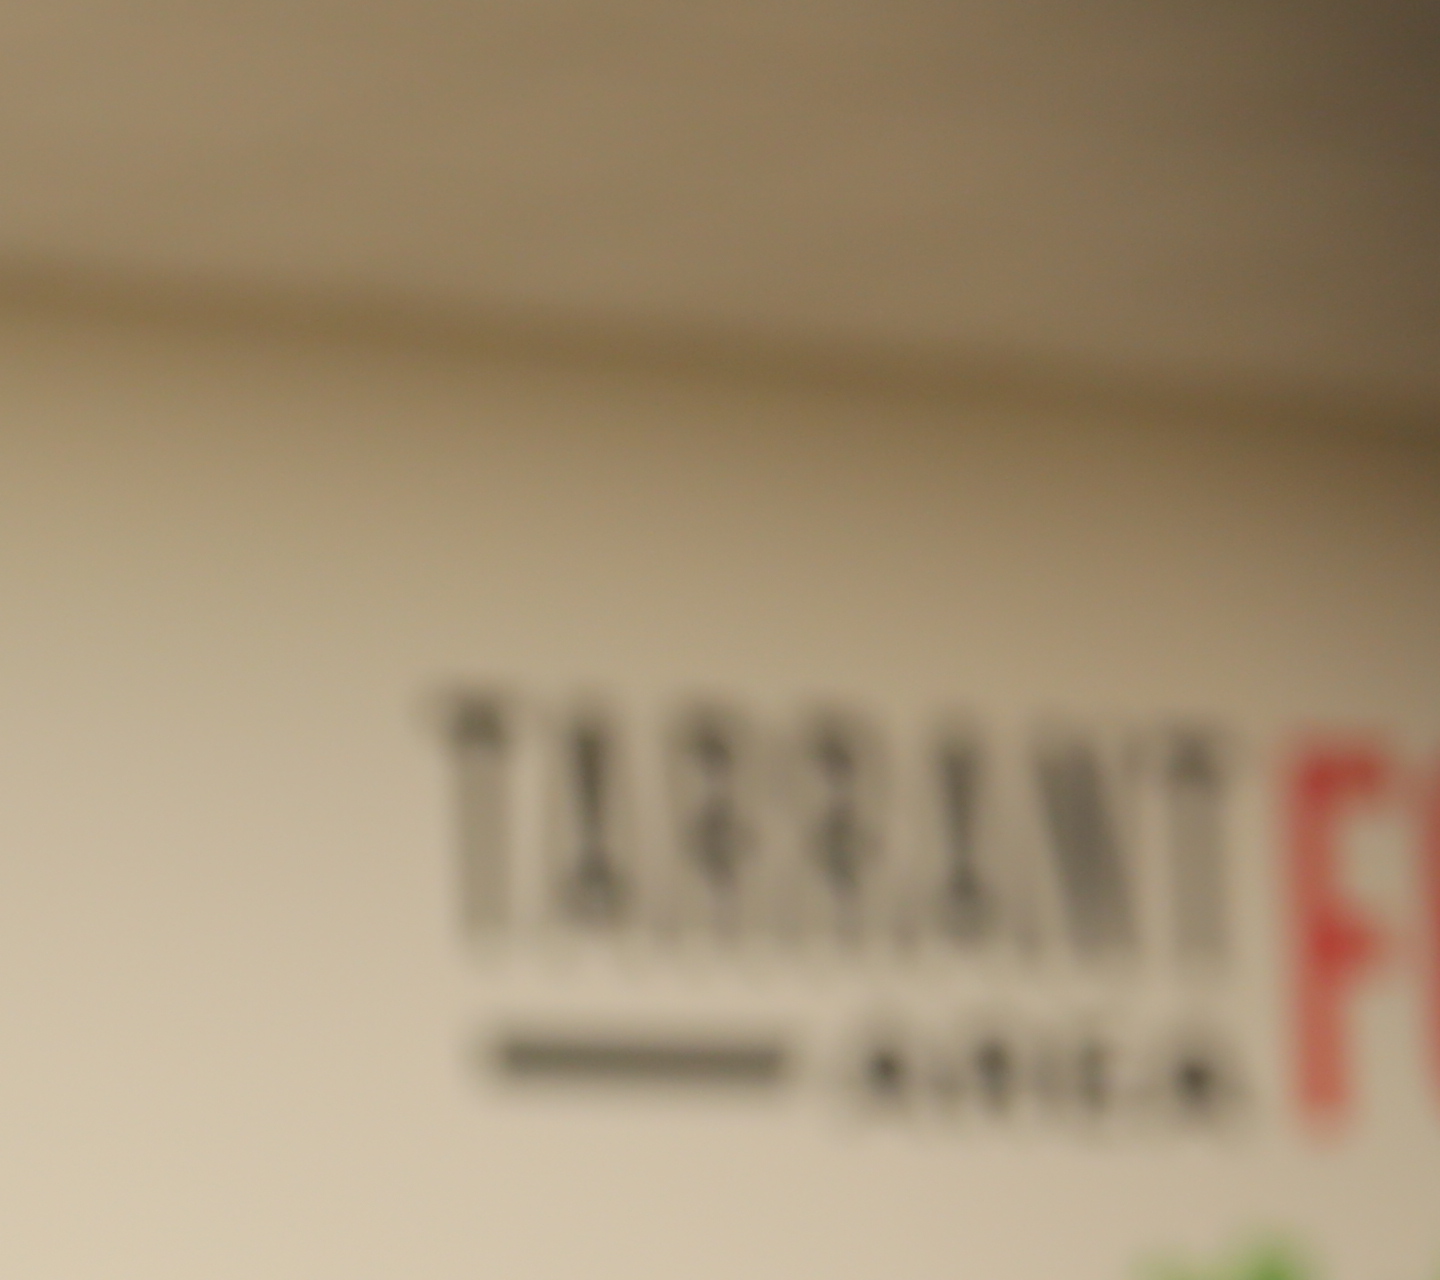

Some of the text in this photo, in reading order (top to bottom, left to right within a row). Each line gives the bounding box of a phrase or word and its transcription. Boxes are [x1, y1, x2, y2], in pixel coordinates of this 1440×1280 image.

[428, 685, 1440, 1136] TARRANT F
[845, 1020, 1242, 1126] AREA
